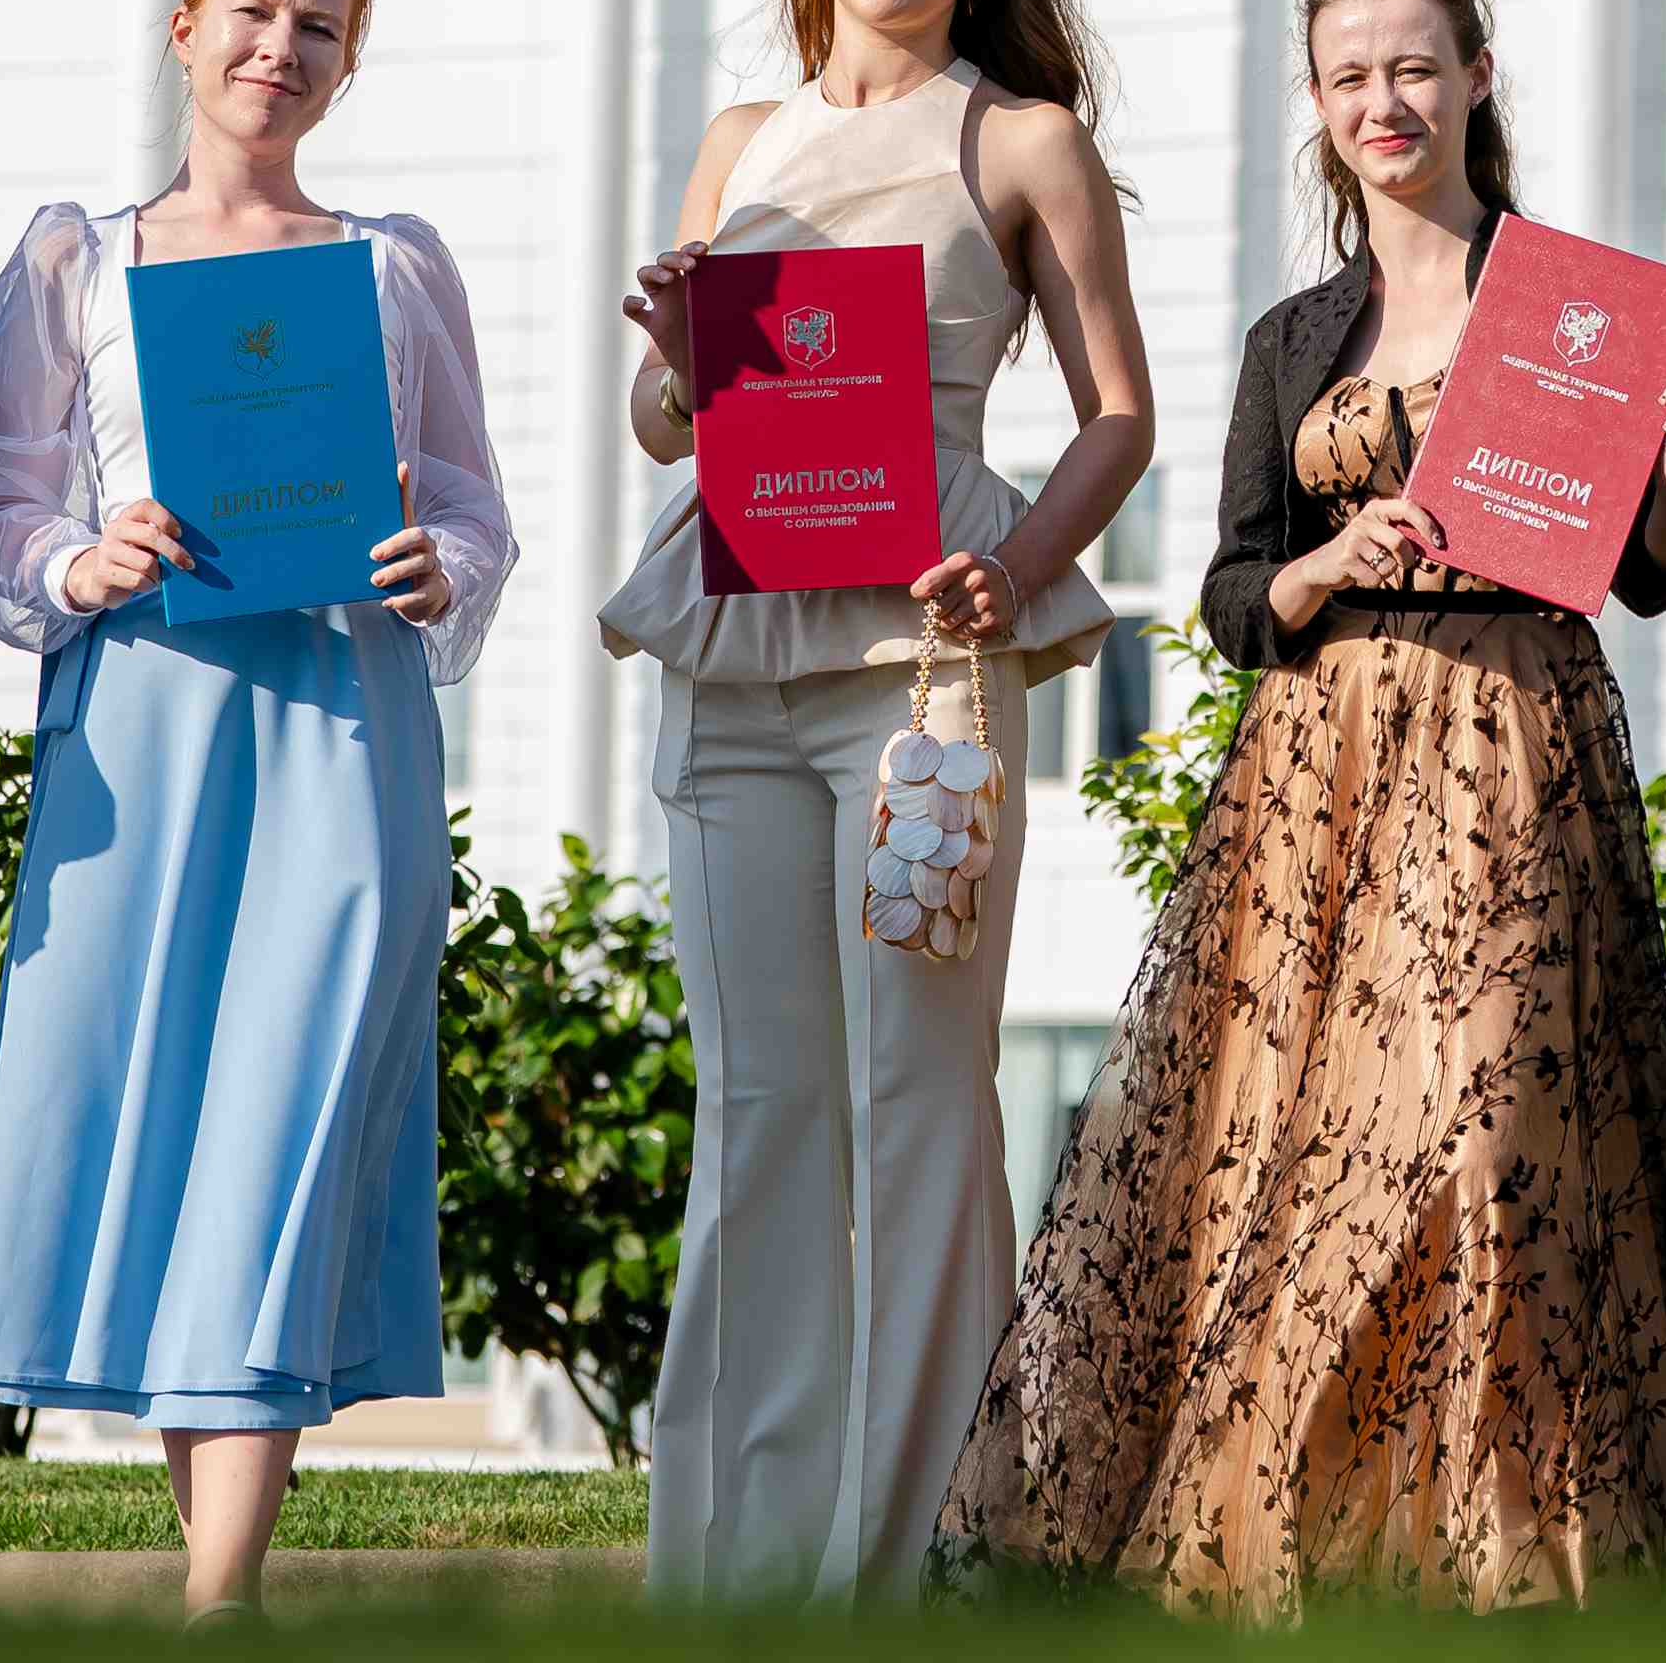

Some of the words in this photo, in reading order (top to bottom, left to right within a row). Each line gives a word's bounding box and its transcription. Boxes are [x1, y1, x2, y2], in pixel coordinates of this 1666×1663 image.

[818, 375, 882, 386] ТЕРРИТОРИЯ
[752, 467, 885, 500] ДИПЛОМ
[1466, 446, 1594, 506] ДИПЛОМ
[744, 508, 755, 518] О
[756, 505, 808, 518] ВЫСШЕМ
[810, 500, 896, 514] ОБРАЗОВАНИИ
[1452, 476, 1463, 487] О
[1462, 479, 1511, 505] ВЫСШЕМ
[1511, 495, 1590, 530] ОБРАЗОВАНИИ
[1483, 500, 1493, 512] С
[1492, 504, 1550, 531] ОТЛИЧИЕМ
[784, 519, 793, 529] С
[795, 516, 858, 529] ОТЛИЧИЕМ
